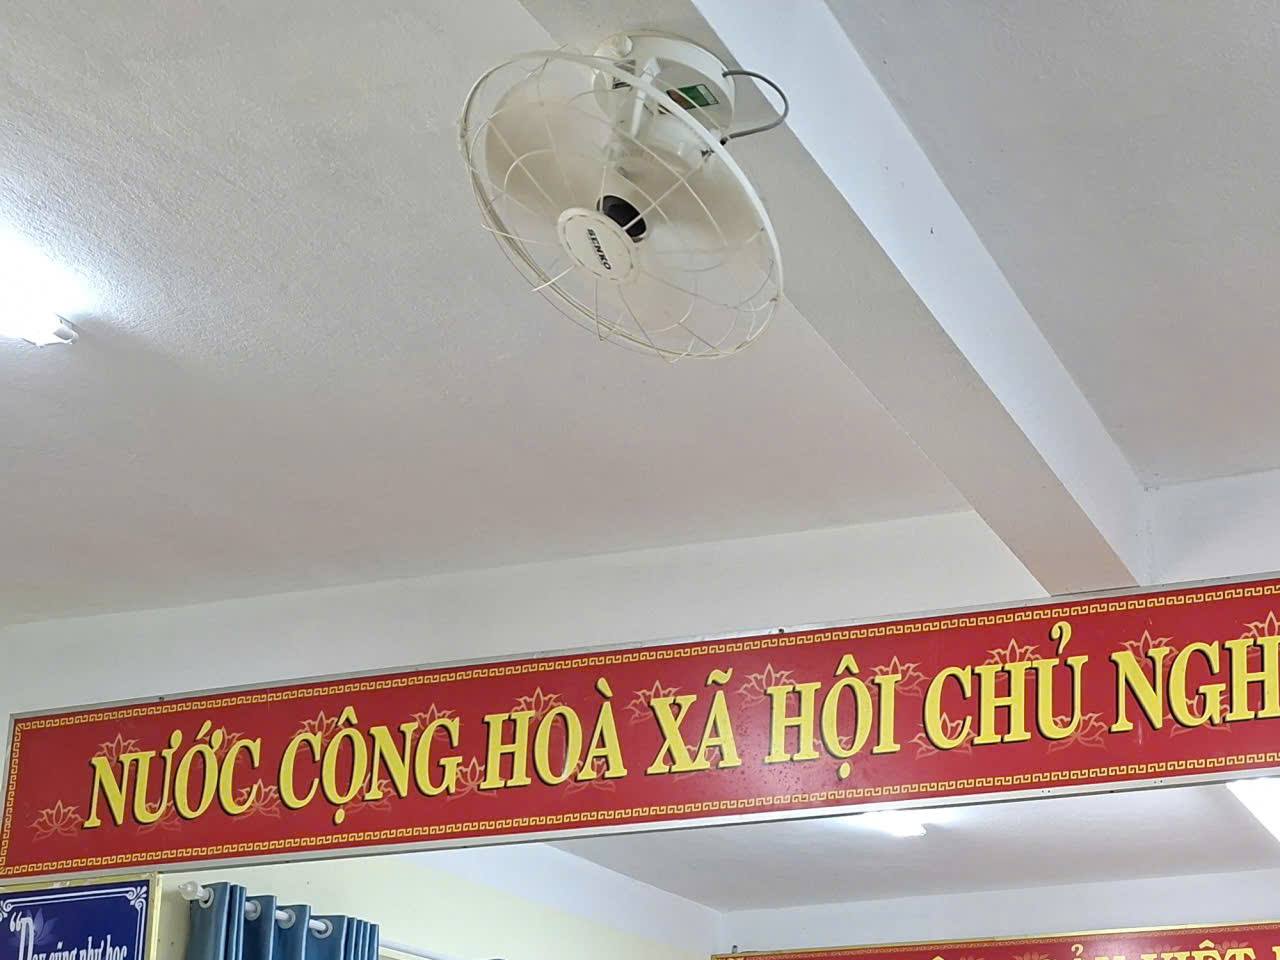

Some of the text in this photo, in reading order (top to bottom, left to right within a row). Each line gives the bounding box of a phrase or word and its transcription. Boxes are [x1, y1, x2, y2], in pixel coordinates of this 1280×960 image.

[83, 723, 262, 832] NƯỚC
[279, 705, 462, 825] CỘNG
[481, 694, 624, 790] HOÀ
[642, 667, 735, 776] XÃ
[764, 656, 900, 784] HỘI
[924, 625, 1079, 750] CHỦ
